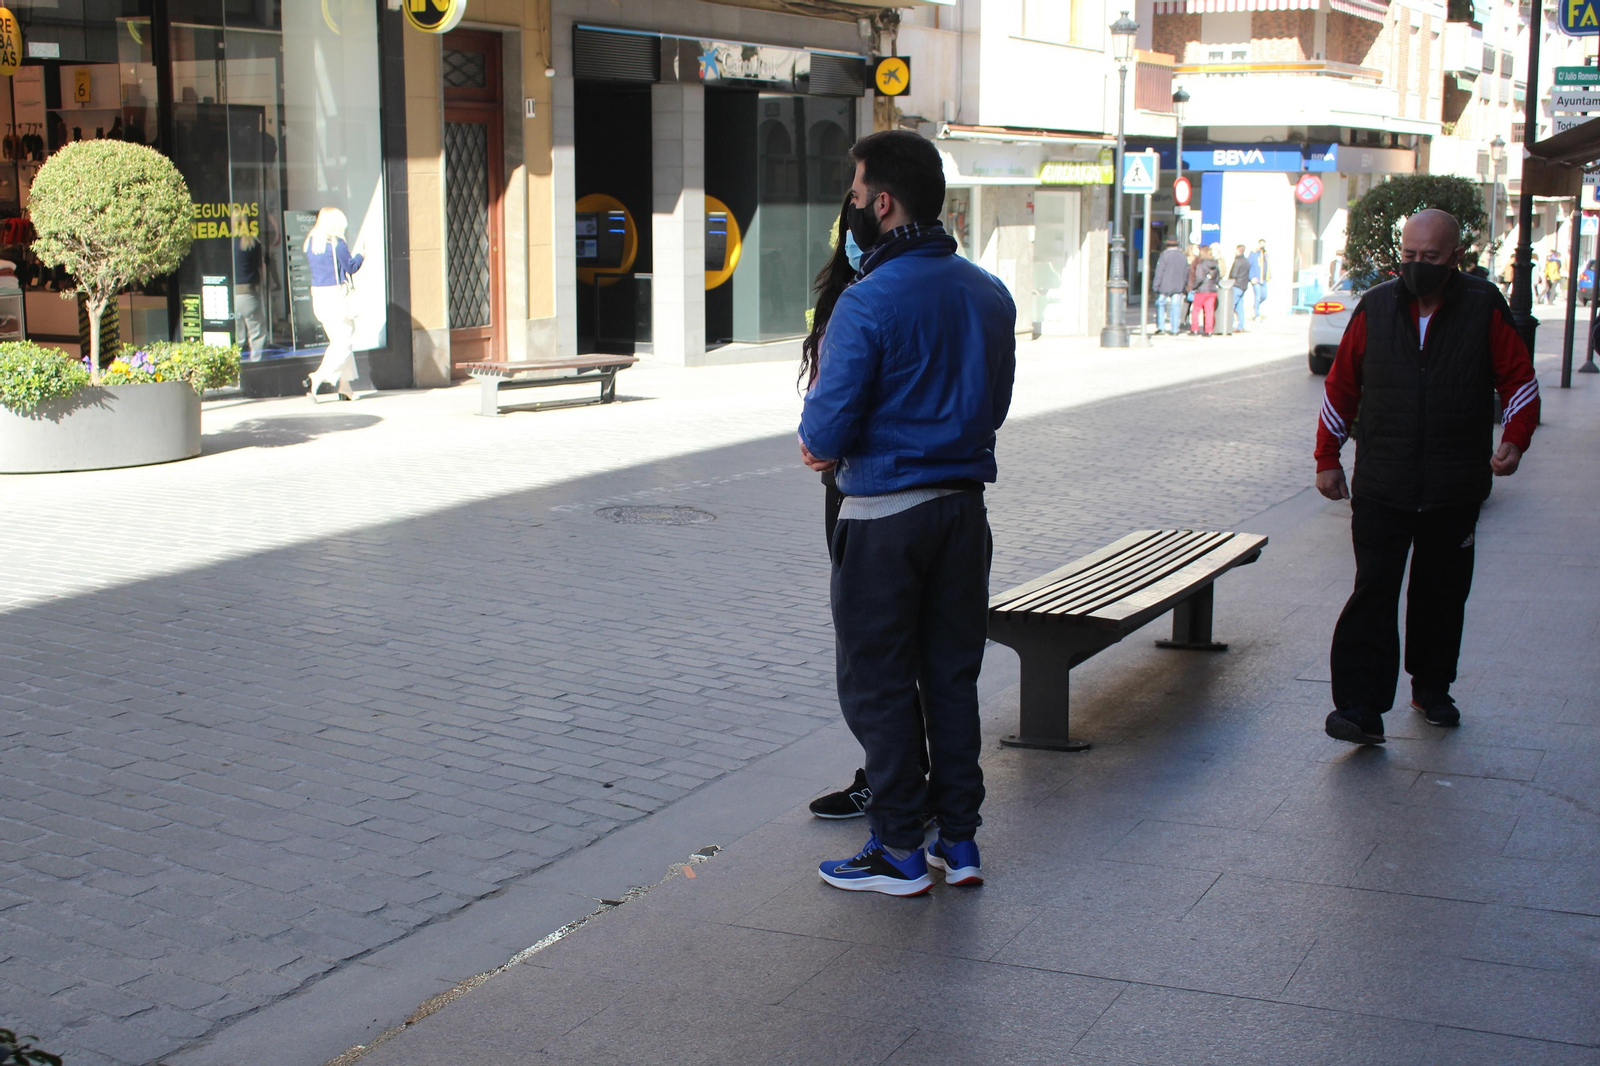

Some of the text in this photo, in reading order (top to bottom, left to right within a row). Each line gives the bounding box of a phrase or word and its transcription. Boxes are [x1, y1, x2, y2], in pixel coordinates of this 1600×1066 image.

[2, 51, 17, 67] AS
[722, 51, 778, 75] CaixaBank
[1565, 72, 1577, 81] Julio
[1578, 72, 1598, 81] Romero
[78, 83, 86, 97] 6
[1213, 149, 1265, 165] BBVA
[192, 202, 259, 218] EGUNDAS
